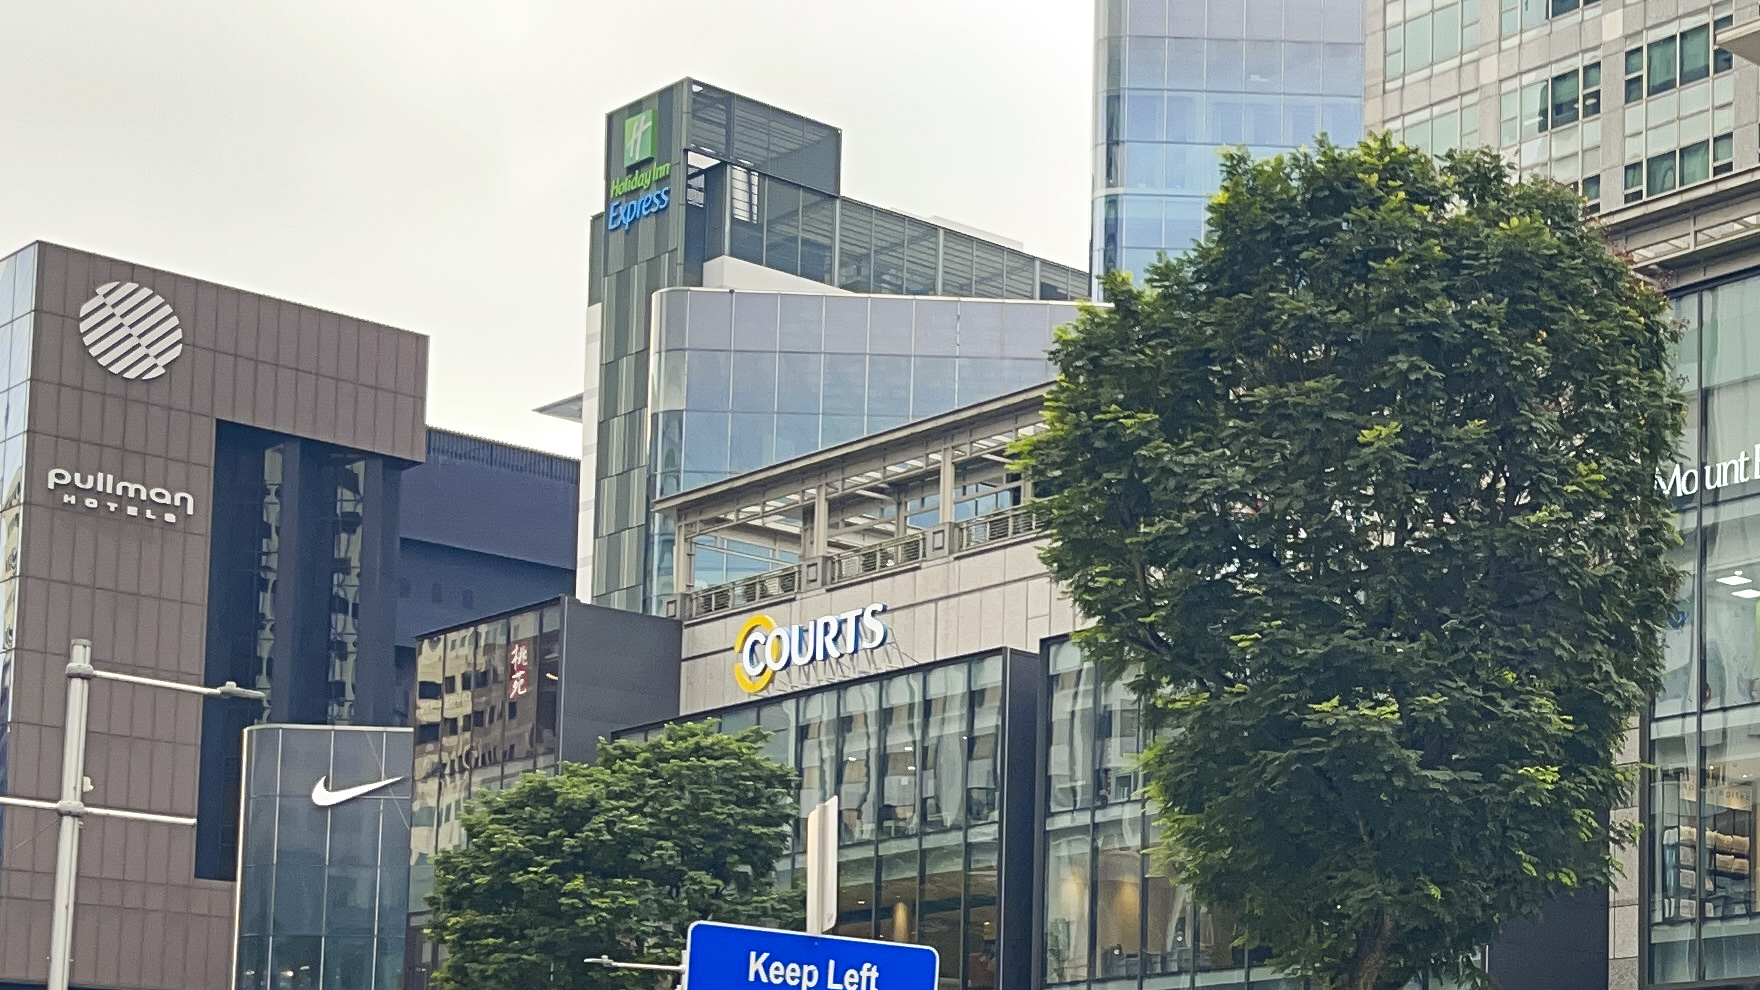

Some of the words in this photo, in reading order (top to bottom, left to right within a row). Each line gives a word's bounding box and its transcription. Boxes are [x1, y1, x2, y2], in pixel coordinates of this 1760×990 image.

[610, 169, 650, 198] Holiday
[653, 161, 672, 181] Inn
[608, 186, 672, 231] Express
[47, 468, 194, 515] pullman
[1654, 450, 1750, 497] Mount
[63, 493, 176, 523] HOTELS
[739, 602, 888, 683] COURTS
